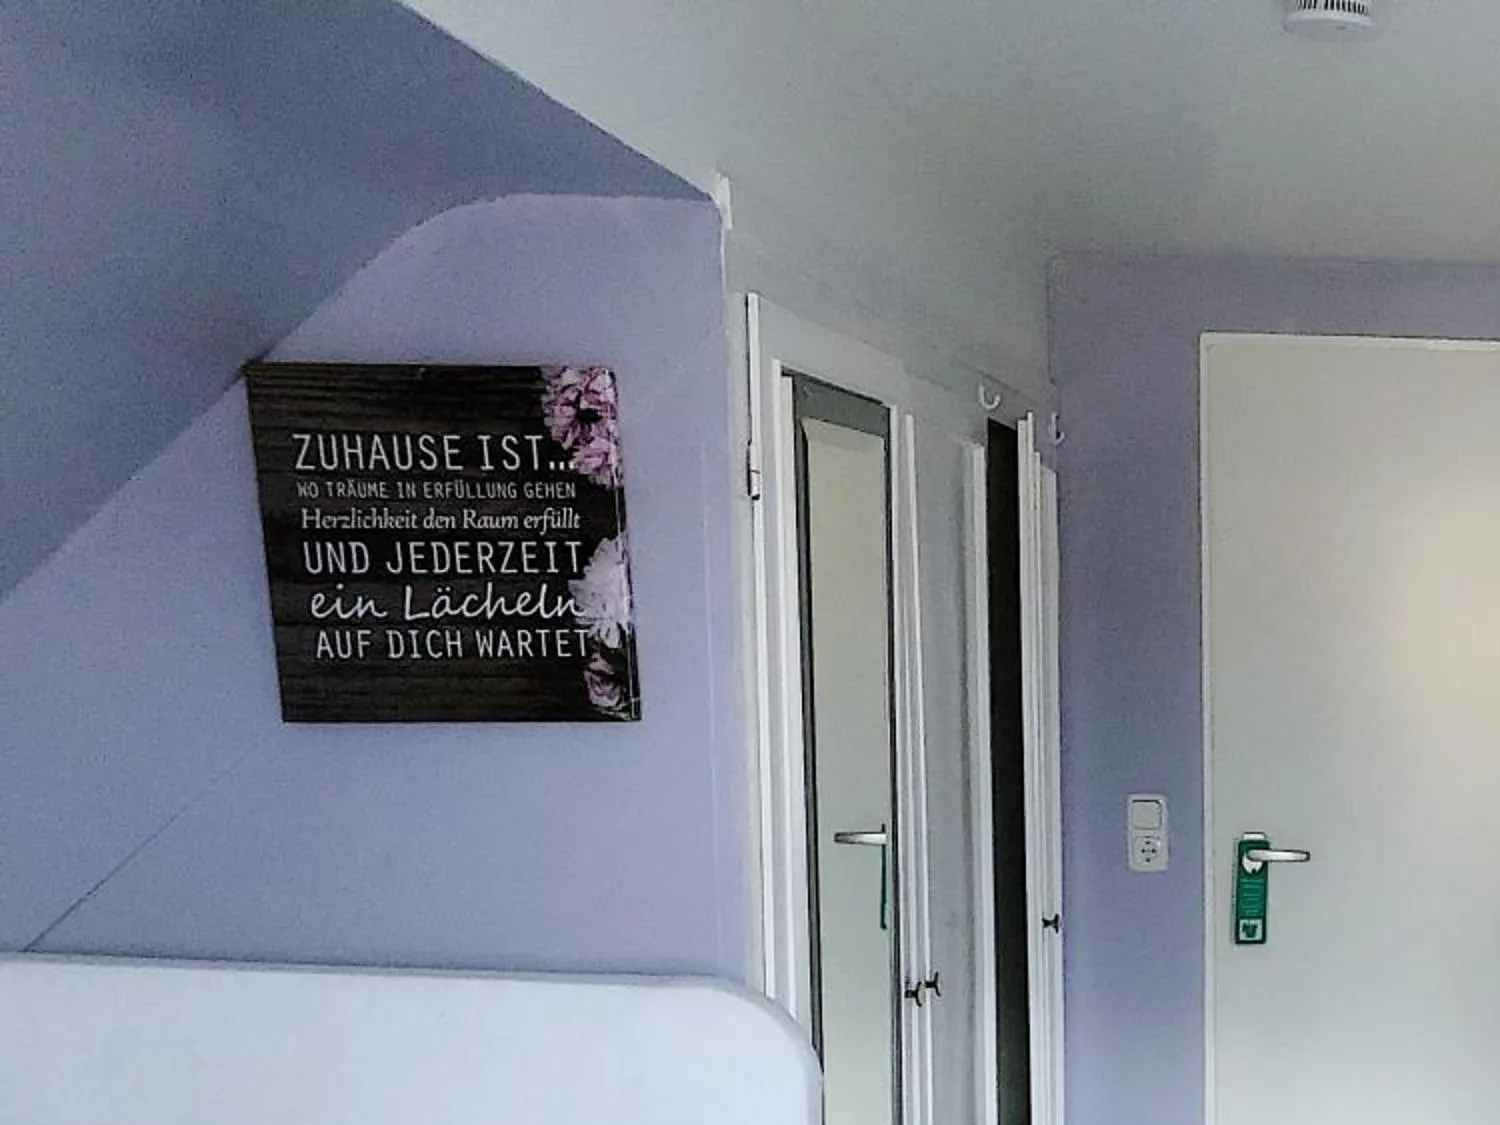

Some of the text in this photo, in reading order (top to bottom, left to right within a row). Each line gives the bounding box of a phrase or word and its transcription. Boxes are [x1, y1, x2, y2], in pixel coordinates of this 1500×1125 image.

[292, 434, 464, 471] ZUHAUSE
[297, 479, 576, 499] WO TRÄUME IN ERFÜLLUNG GEHEN
[301, 507, 581, 536] Herzlichkeit den Raum erfüllt
[303, 541, 583, 574] UND JEDERZEIT
[310, 582, 586, 621] ein Lächeln
[316, 629, 590, 659] AUF DICH WARTET
